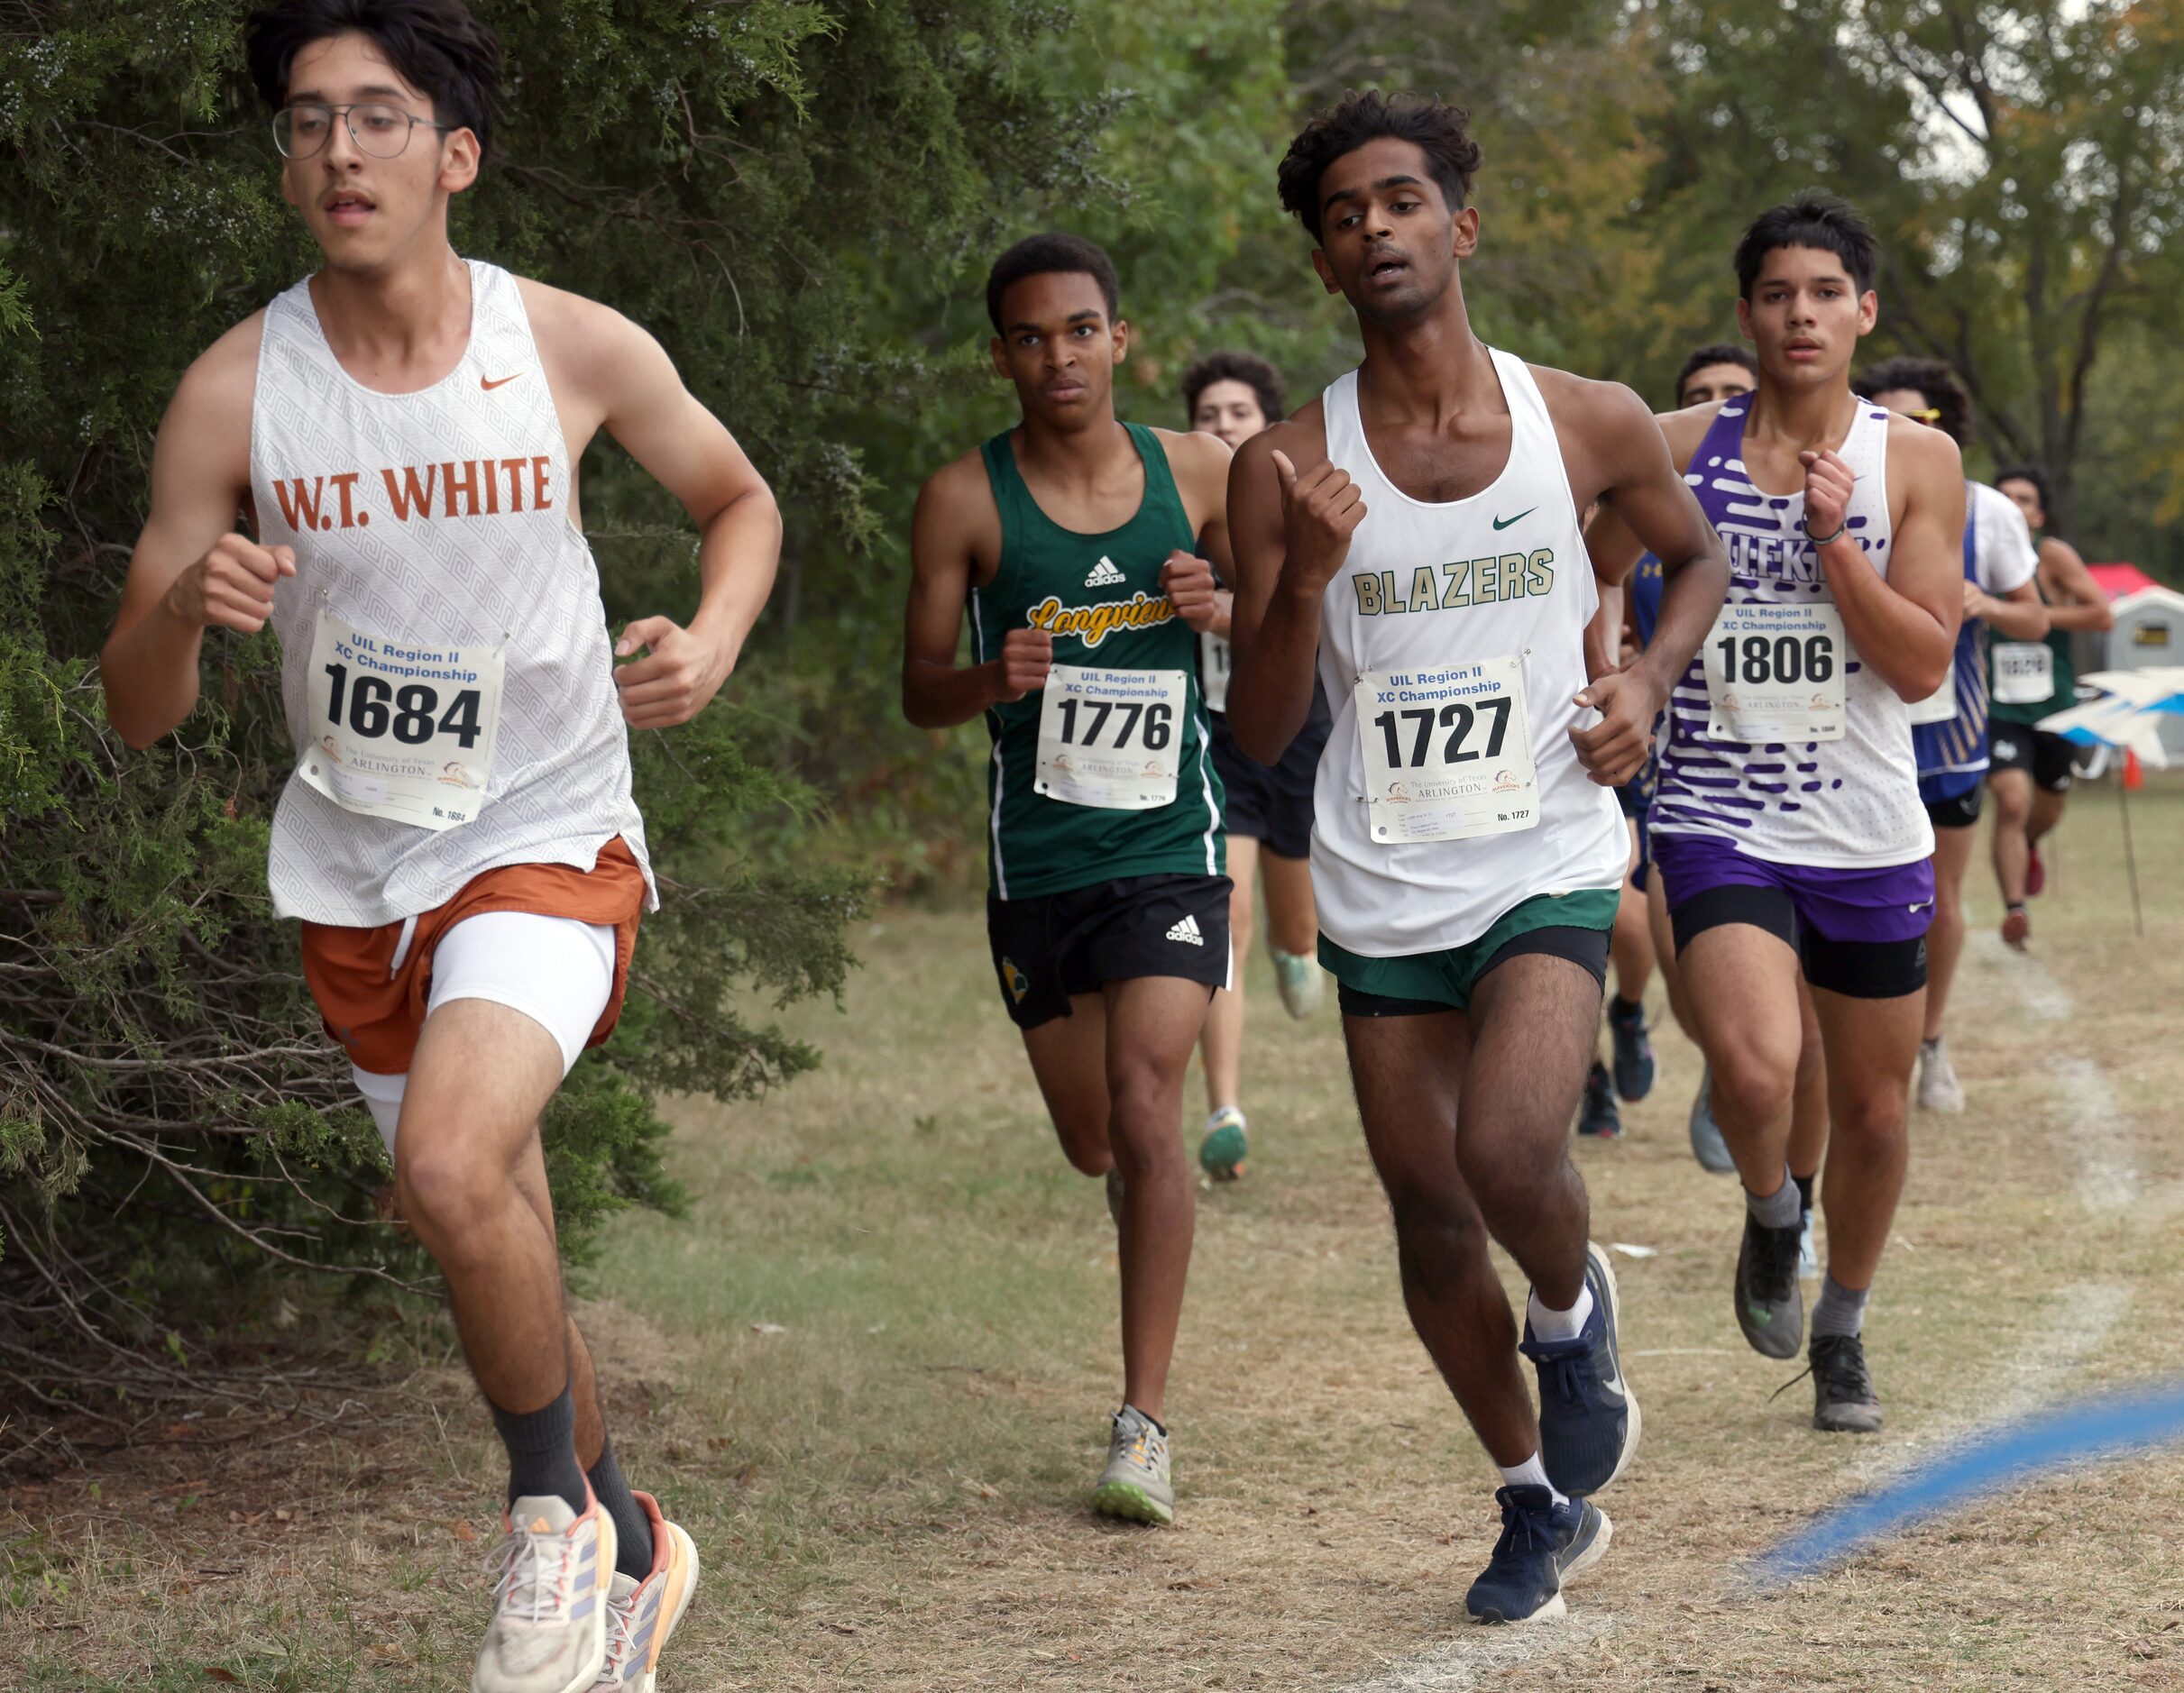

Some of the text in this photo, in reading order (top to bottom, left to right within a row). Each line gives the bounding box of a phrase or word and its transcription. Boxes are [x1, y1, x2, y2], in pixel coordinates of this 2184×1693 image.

[271, 455, 554, 533] W.T. WHITE
[1719, 530, 1831, 582] UFK
[1084, 572, 1126, 589] adidas
[1352, 547, 1555, 616] BLAZERS
[1026, 590, 1178, 648] Longview
[1736, 609, 1812, 619] UIL Region II
[1722, 621, 1827, 632] XC Championship
[352, 633, 459, 663] UIL Region II
[335, 641, 477, 683] XC Championship
[1717, 636, 1833, 684] 1806
[1080, 672, 1156, 685] UIL Region II
[1390, 666, 1482, 687] UIL Region II
[1065, 682, 1169, 699] XC Championship
[1377, 681, 1501, 703] XC Championship
[325, 663, 482, 749] 1684
[1057, 698, 1172, 751] 1776
[1374, 696, 1512, 768] 1727
[350, 757, 426, 776] ARLINGTON
[362, 750, 399, 764] University
[1418, 782, 1482, 799] ARLINGTON
[1424, 778, 1456, 789] University
[1458, 776, 1467, 784] of
[1468, 774, 1487, 782] Texas
[1491, 784, 1520, 792] MAVERICKS
[433, 806, 465, 821] No. 1684
[1497, 810, 1529, 822] No. 1727
[1165, 930, 1204, 947] adidas
